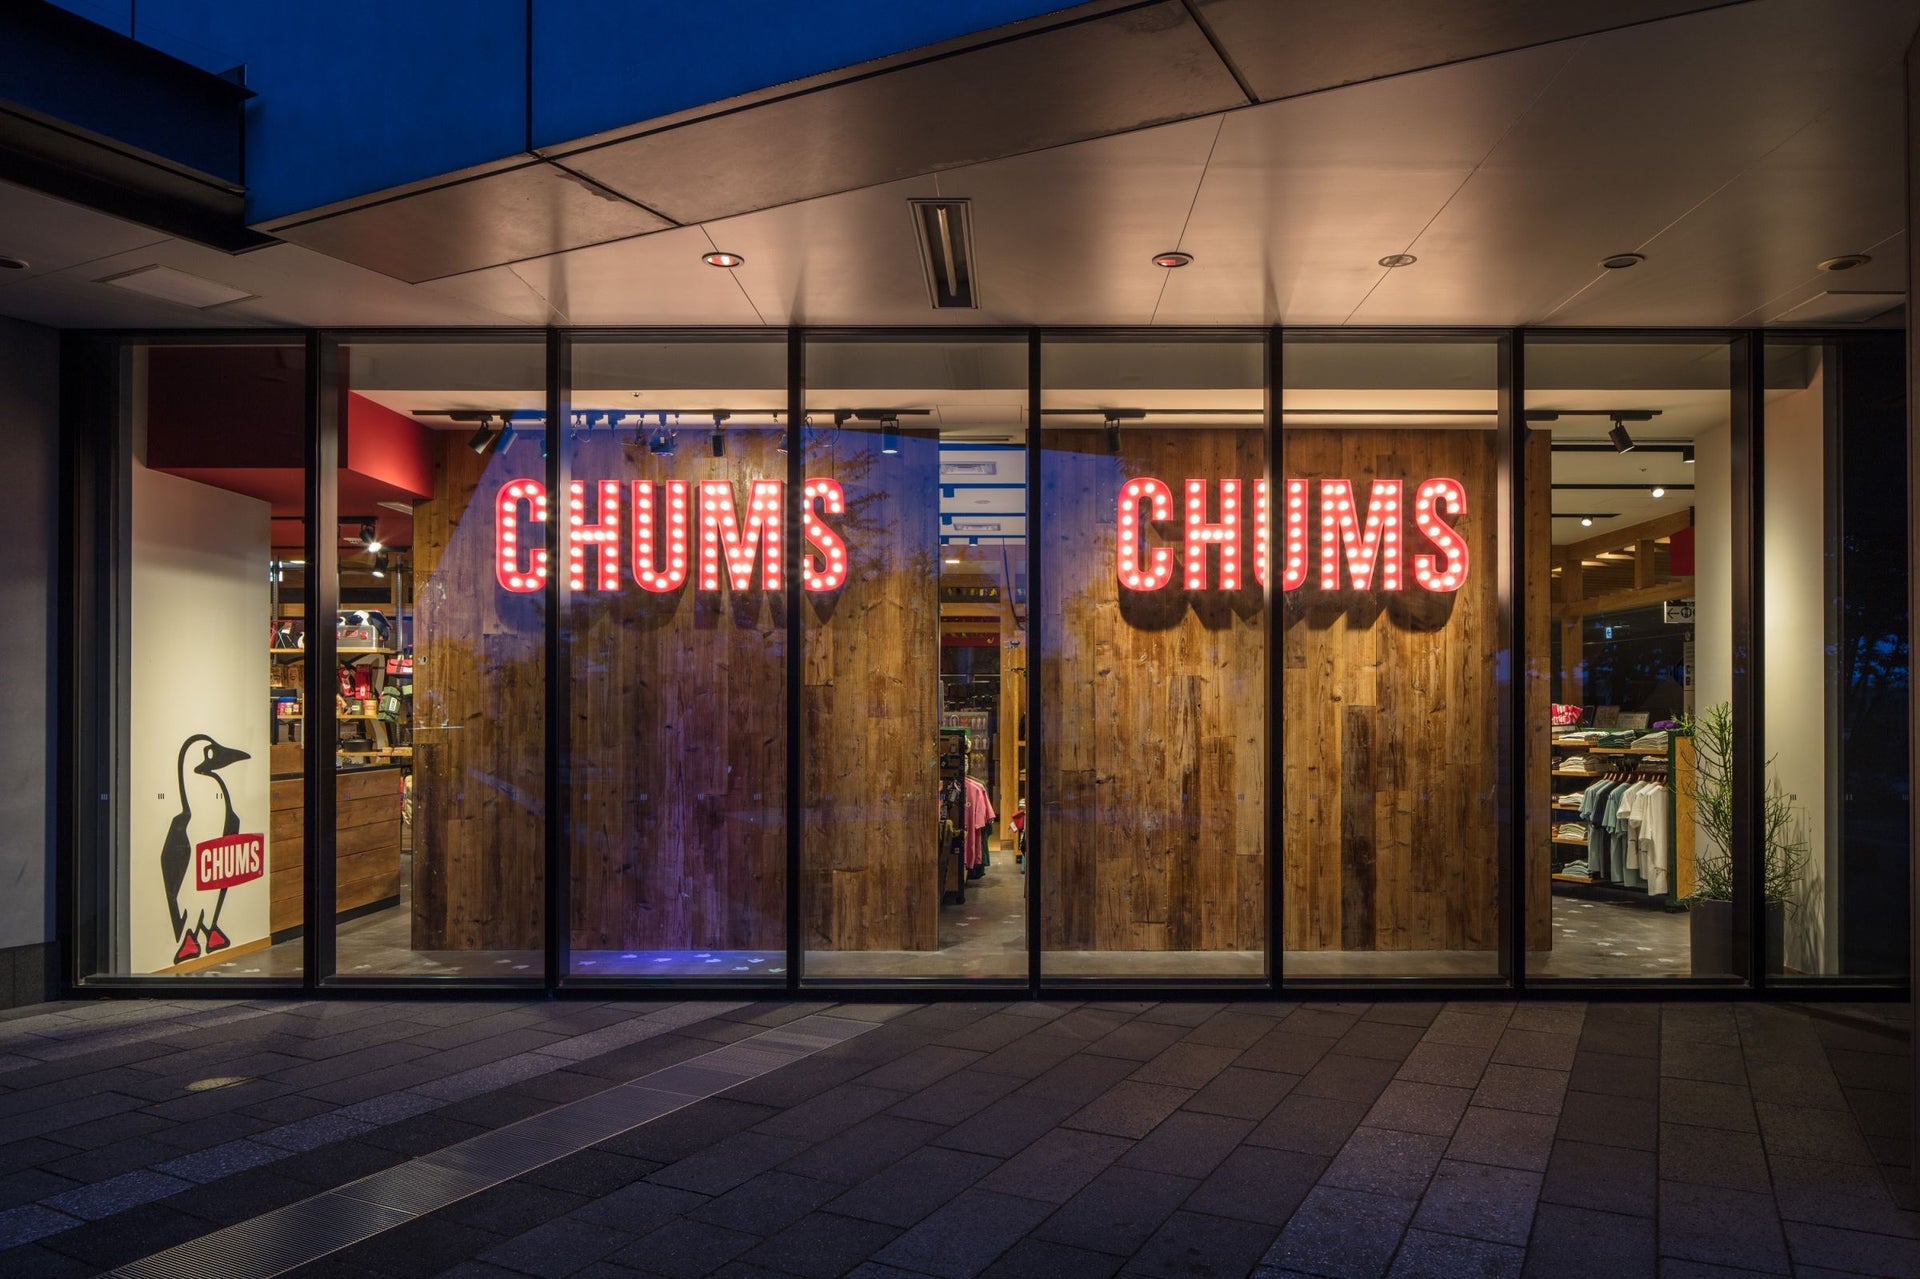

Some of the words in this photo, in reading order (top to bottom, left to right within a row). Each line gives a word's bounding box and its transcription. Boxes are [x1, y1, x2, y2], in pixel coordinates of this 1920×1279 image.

[496, 478, 848, 592] CHUMS
[1118, 477, 1469, 592] CHUMS
[201, 840, 259, 883] CHUMS
